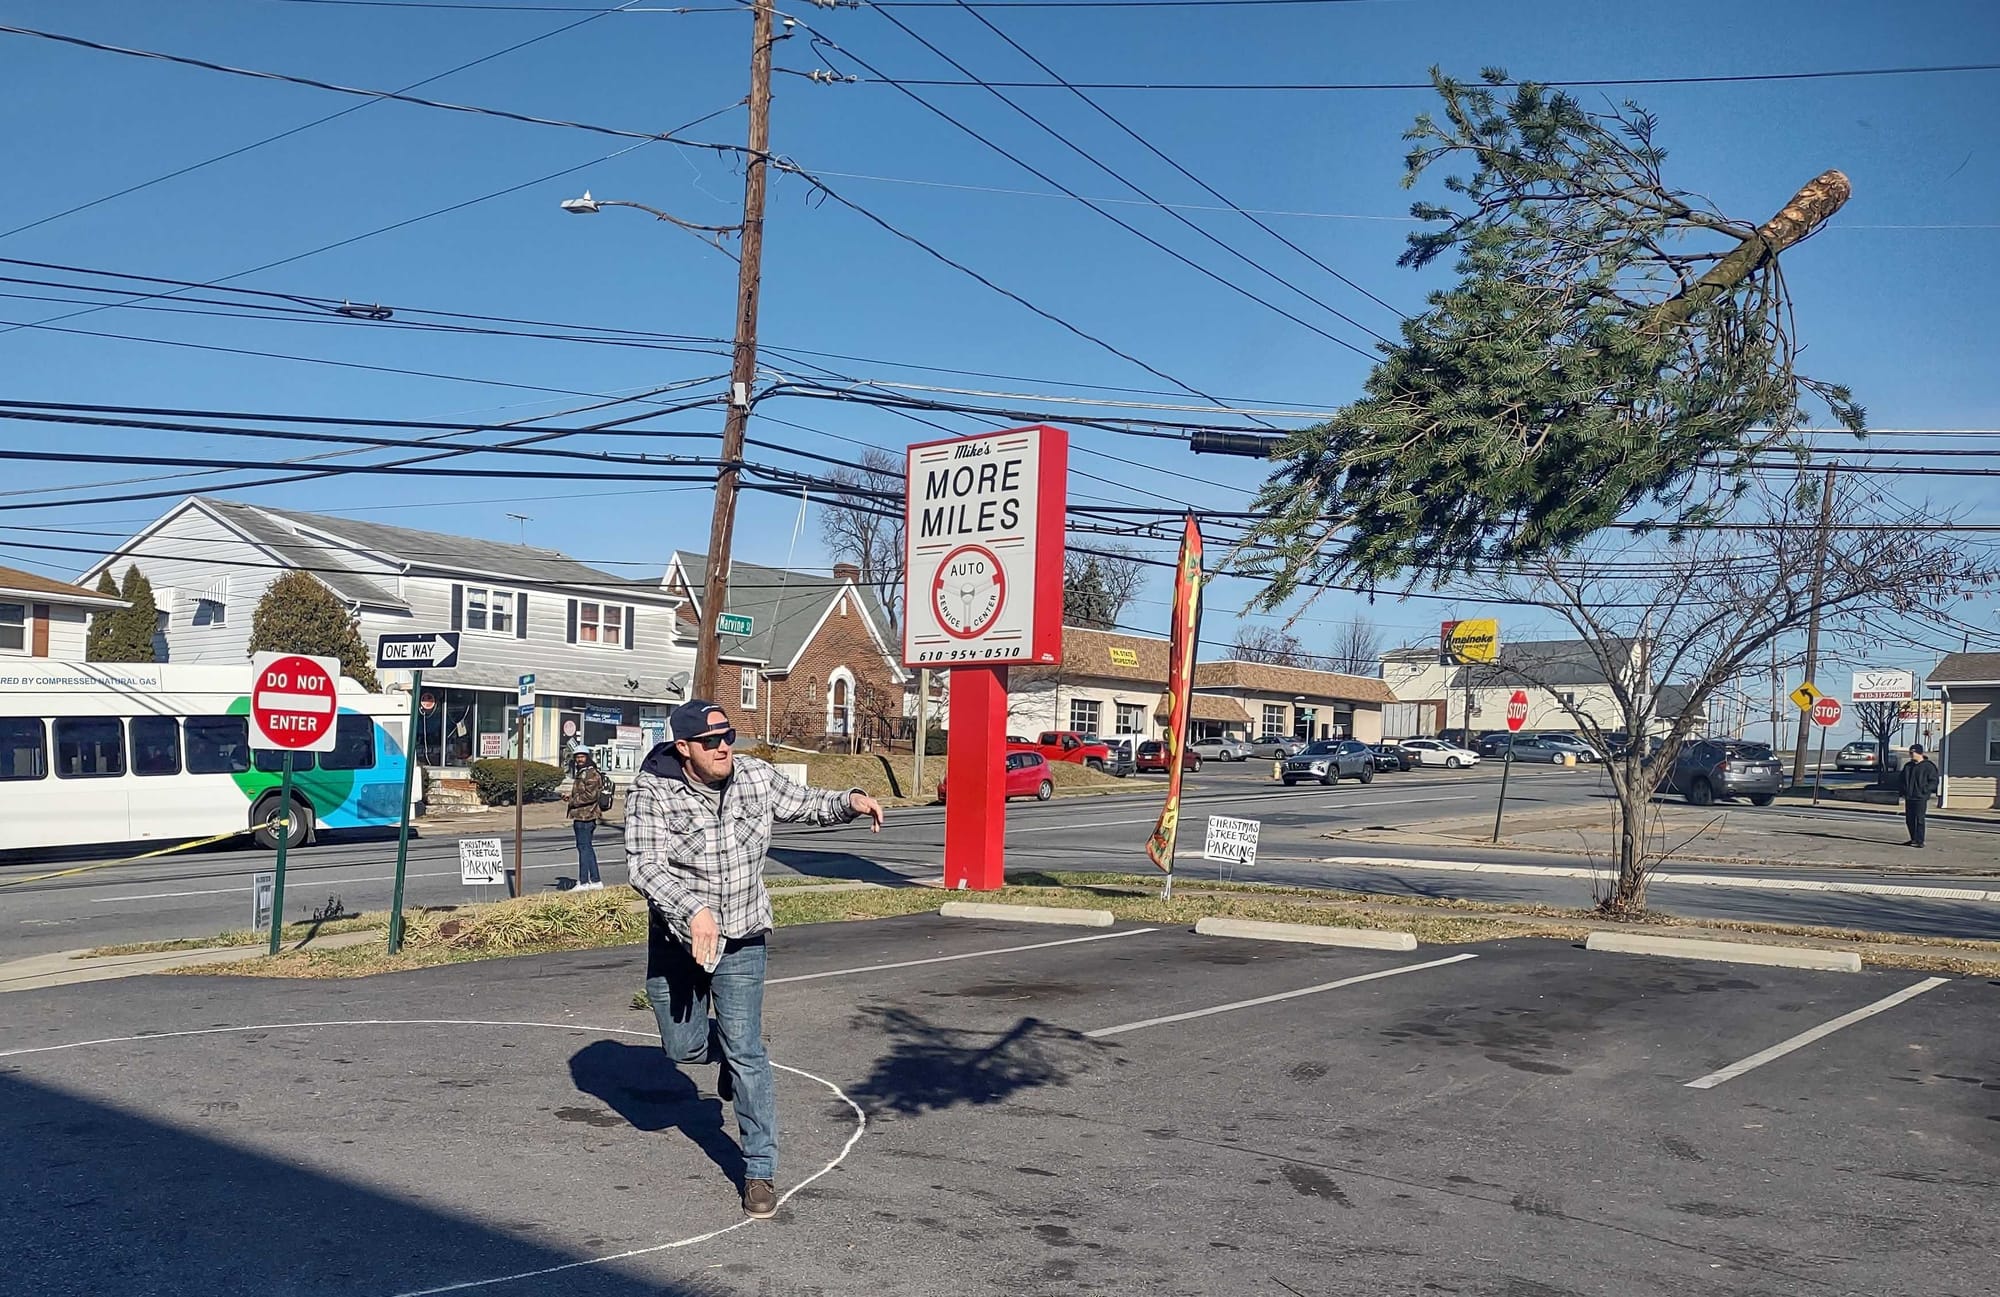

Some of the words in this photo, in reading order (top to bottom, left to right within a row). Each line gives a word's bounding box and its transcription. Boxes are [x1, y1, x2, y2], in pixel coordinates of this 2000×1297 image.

[954, 441, 992, 459] Mike's
[926, 459, 1022, 500] MORE
[921, 498, 1020, 538] MILES
[950, 561, 984, 577] AUTO
[939, 594, 961, 628] SERVICE
[973, 594, 997, 627] CENTER
[720, 615, 745, 632] Marvine
[386, 644, 407, 658] ONE
[412, 643, 435, 658] WAY
[919, 647, 1020, 661] 610-954-0510
[21, 677, 34, 685] BY
[35, 677, 96, 685] COMPRESSED
[98, 677, 137, 686] NATURAL
[139, 678, 157, 686] GAS
[266, 672, 288, 688] DO
[297, 675, 326, 691] NOT
[1858, 674, 1903, 690] Star
[585, 703, 622, 714] Panasonic
[1508, 702, 1528, 719] STOP
[1814, 706, 1840, 718] STOP
[269, 714, 318, 732] ENTER
[1210, 818, 1258, 833] CHRISTMAS
[1215, 829, 1237, 840] TREE
[1238, 832, 1256, 844] TOSS
[1207, 839, 1255, 861] PARKING
[462, 859, 503, 875] PARKING
